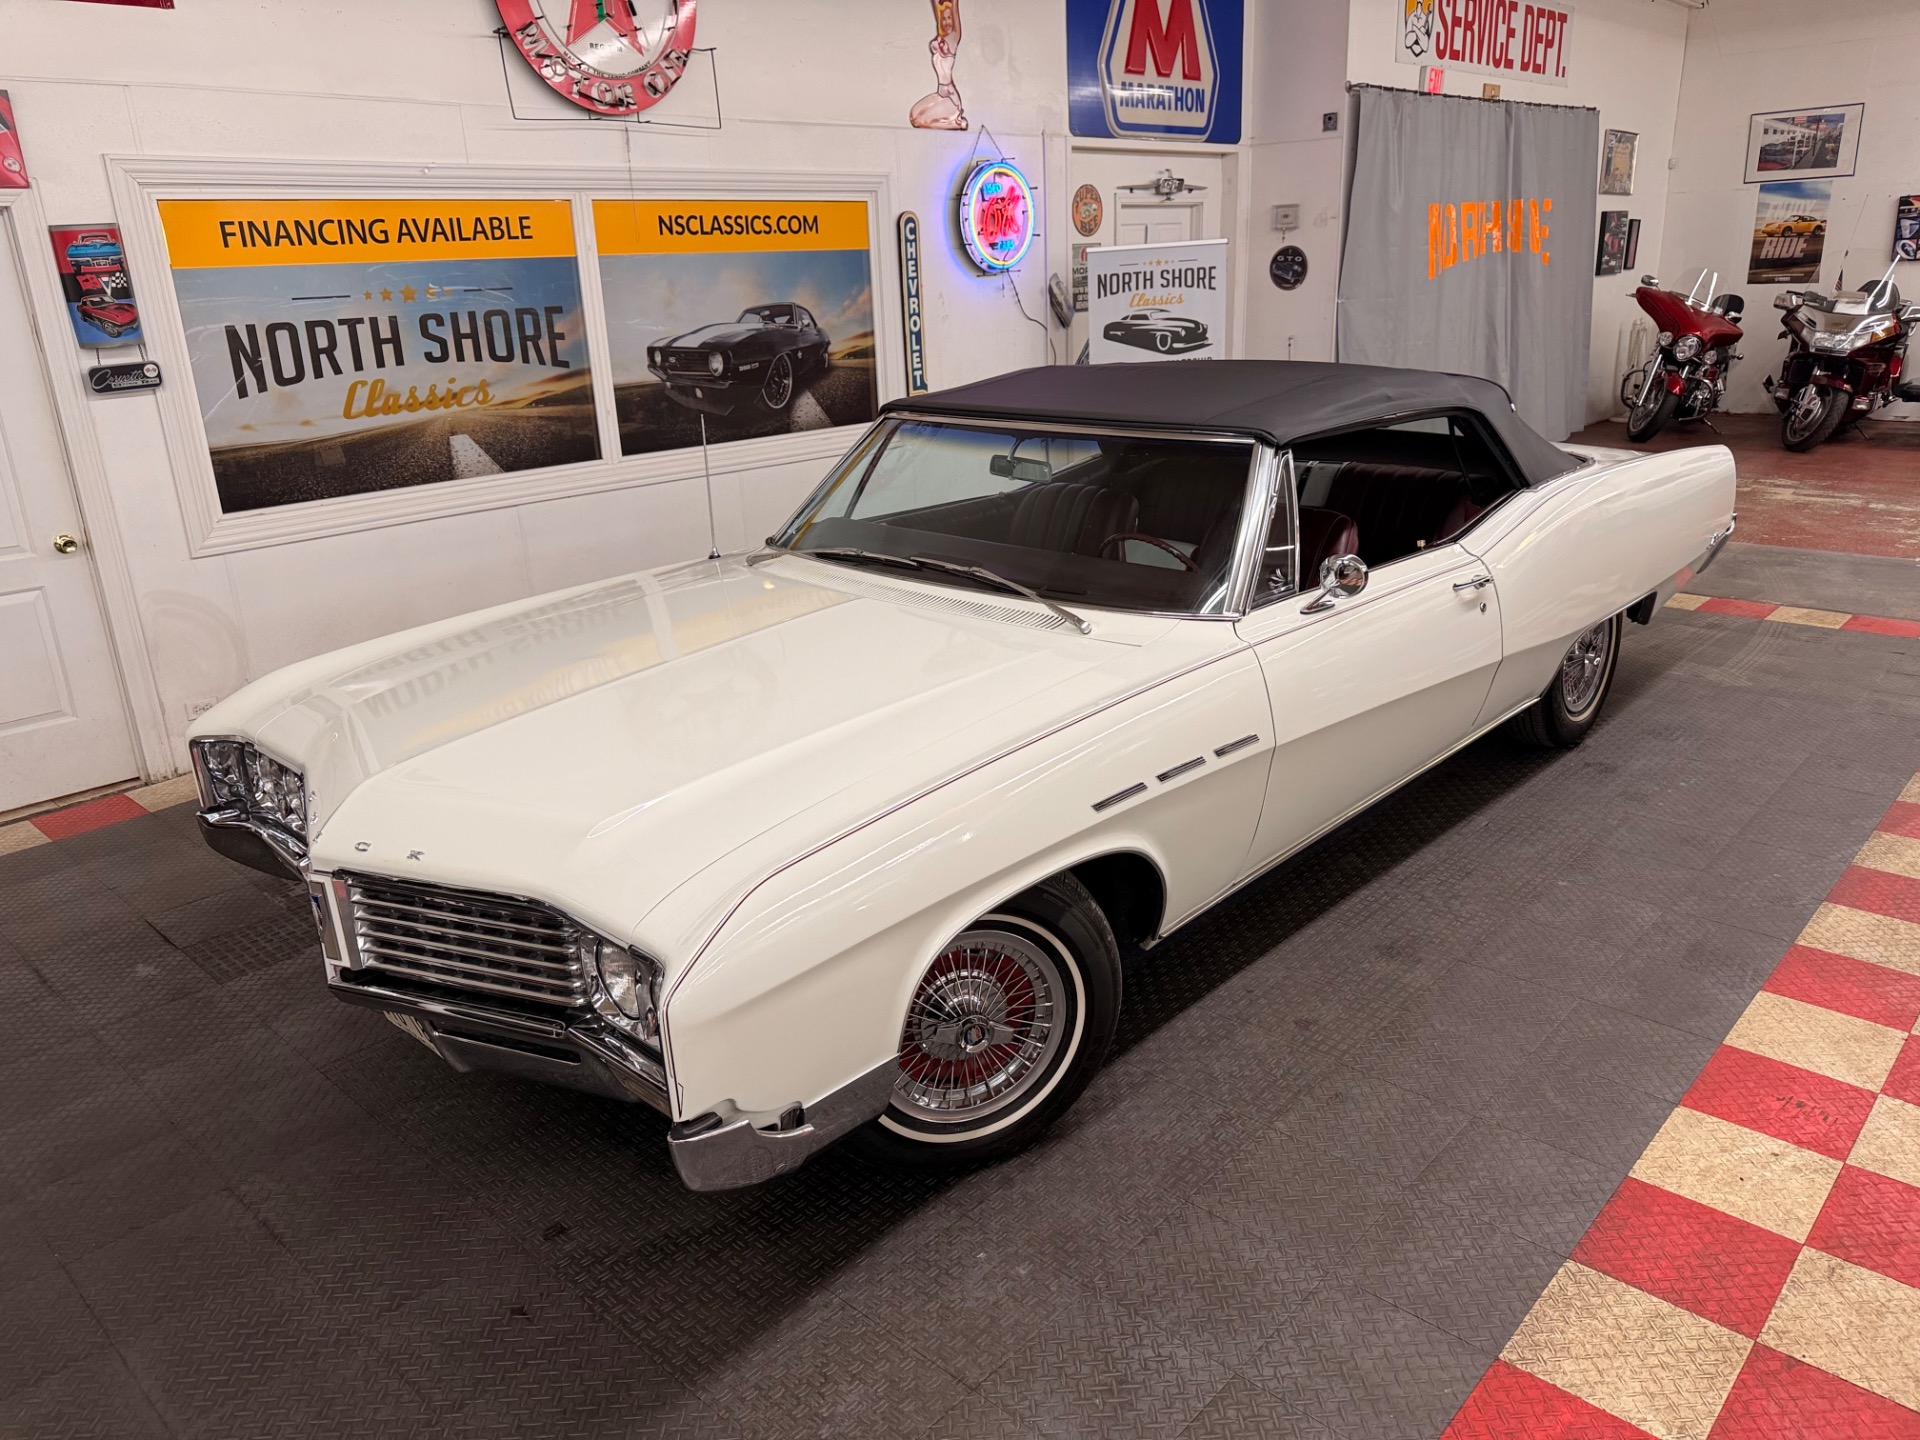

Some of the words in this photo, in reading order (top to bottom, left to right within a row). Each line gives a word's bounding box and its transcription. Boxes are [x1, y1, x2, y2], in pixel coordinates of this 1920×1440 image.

[1124, 0, 1202, 82] M
[1435, 0, 1518, 70] SERVICE
[1520, 4, 1568, 78] DEPT.
[516, 21, 638, 112] MOTOR
[643, 47, 691, 98] OIL
[1427, 67, 1444, 94] EXIT
[1119, 81, 1205, 113] MARATHON
[218, 218, 390, 249] FINANCING
[396, 215, 534, 245] AVAILABLE
[658, 214, 820, 237] NSCLASSICS.COM
[1080, 213, 1099, 233] BEE
[1759, 236, 1808, 259] RIDE
[1097, 270, 1154, 299] NORTH
[1160, 266, 1217, 291] SHORE
[905, 222, 924, 388] CHEVROLET
[1128, 292, 1184, 308] Classics
[225, 314, 405, 399] NORTH
[417, 305, 571, 369] SHORE
[91, 369, 146, 390] Corvette
[342, 376, 497, 421] Classics
